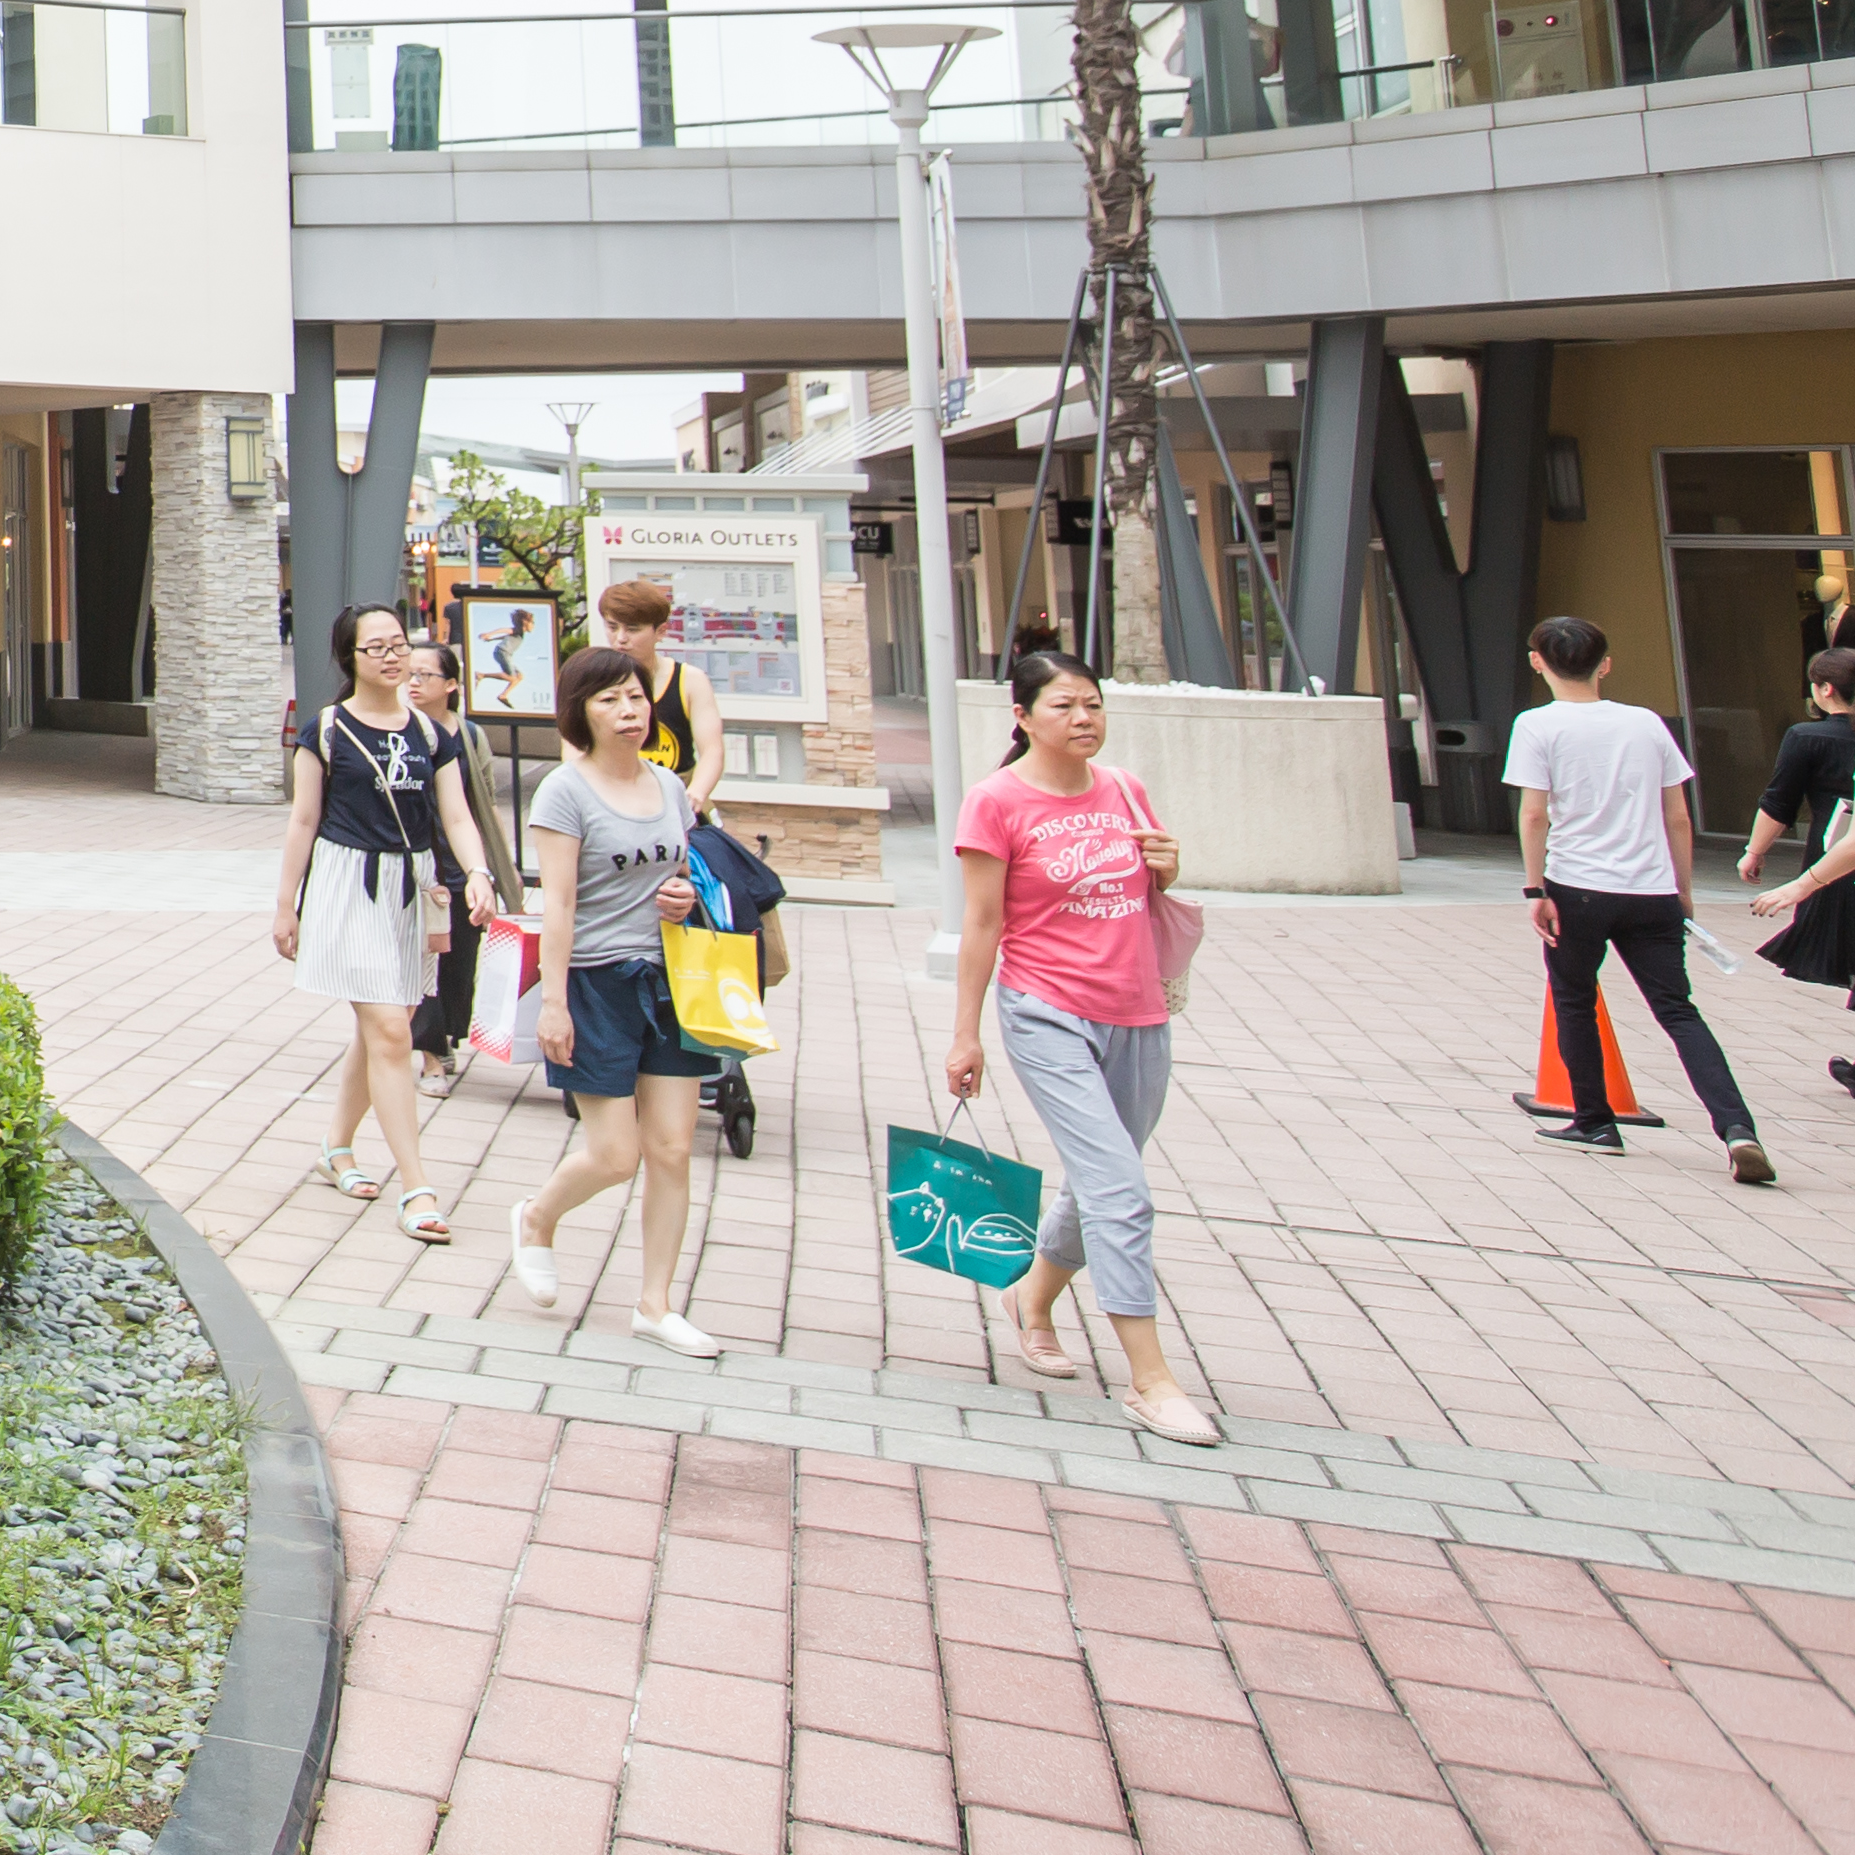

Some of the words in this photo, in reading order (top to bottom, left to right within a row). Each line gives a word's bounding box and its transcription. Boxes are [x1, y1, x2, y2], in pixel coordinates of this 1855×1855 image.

[631, 528, 704, 545] GLORIA
[710, 529, 798, 547] OUTLETS
[1028, 812, 1132, 843] DISCOVERY
[611, 844, 686, 871] PARI
[1099, 882, 1124, 894] No.1
[1056, 895, 1145, 920] AMAZIN
[1081, 895, 1126, 905] RESULTS
